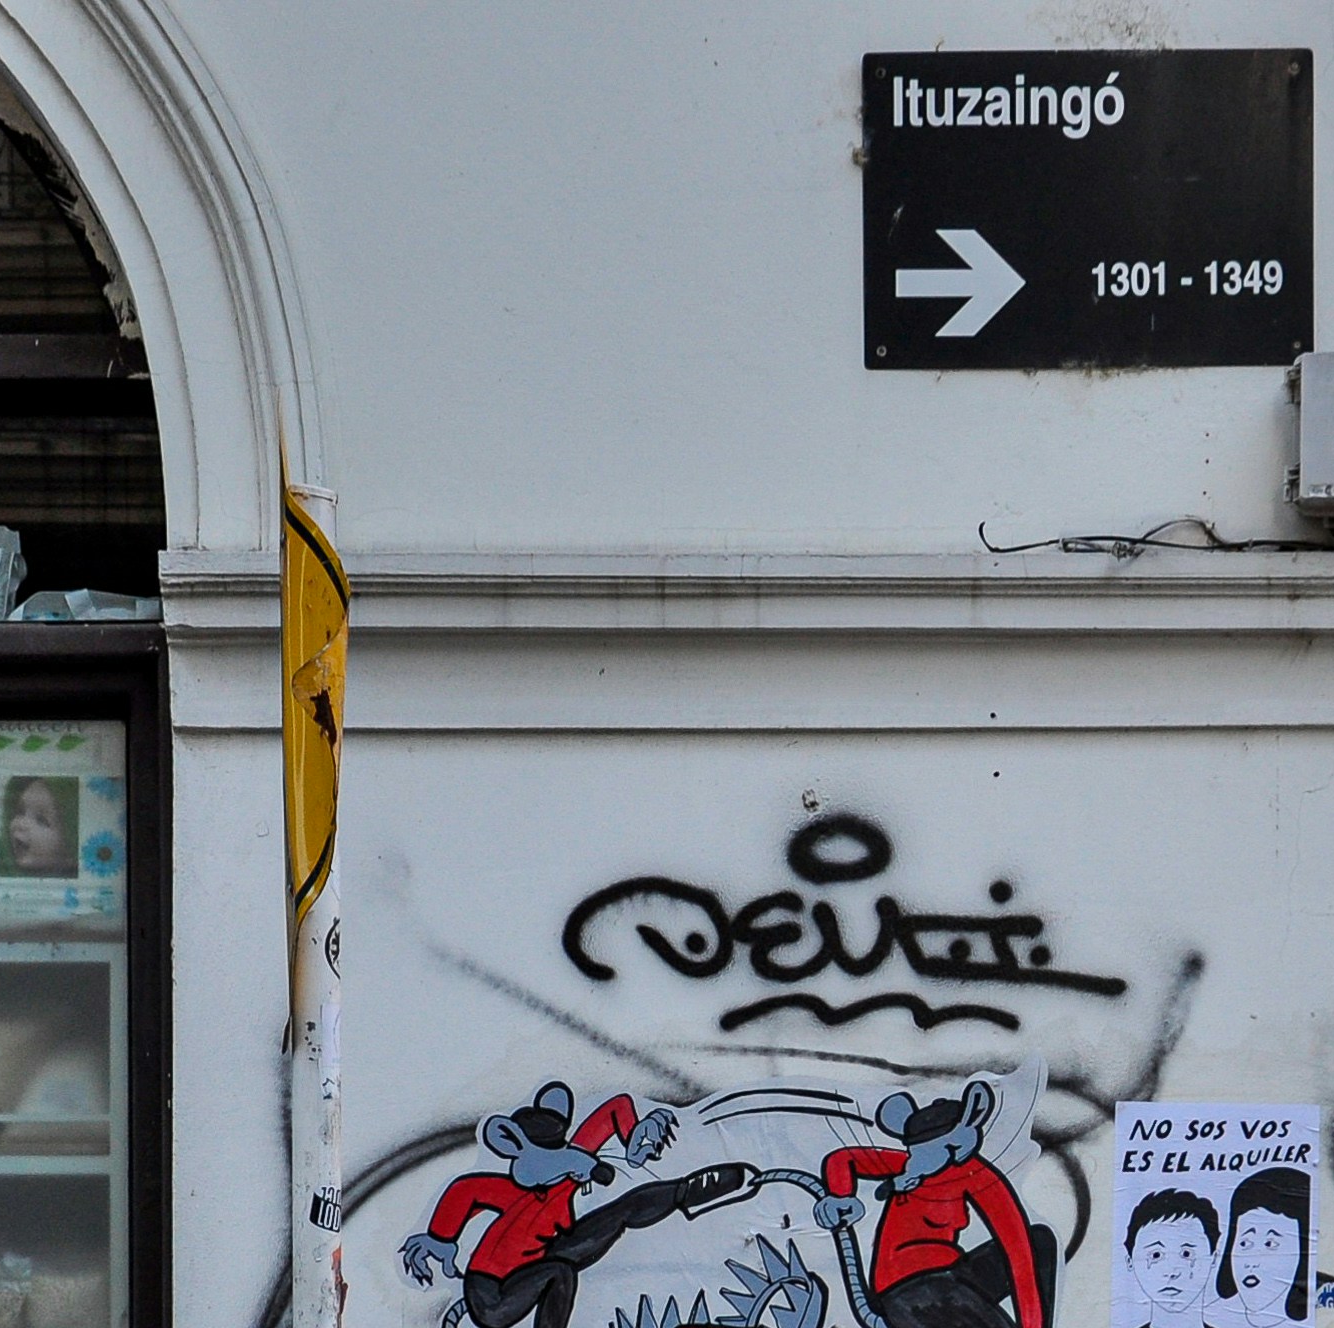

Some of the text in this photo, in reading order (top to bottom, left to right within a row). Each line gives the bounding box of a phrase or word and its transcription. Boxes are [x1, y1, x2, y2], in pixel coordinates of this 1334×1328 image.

[892, 71, 1125, 139] Ituzaingó
[1091, 261, 1166, 297] 1301
[1203, 259, 1284, 297] 1349
[1129, 1119, 1293, 1142] NO SOS VOS
[1122, 1142, 1313, 1173] ES EL ALQUILER
